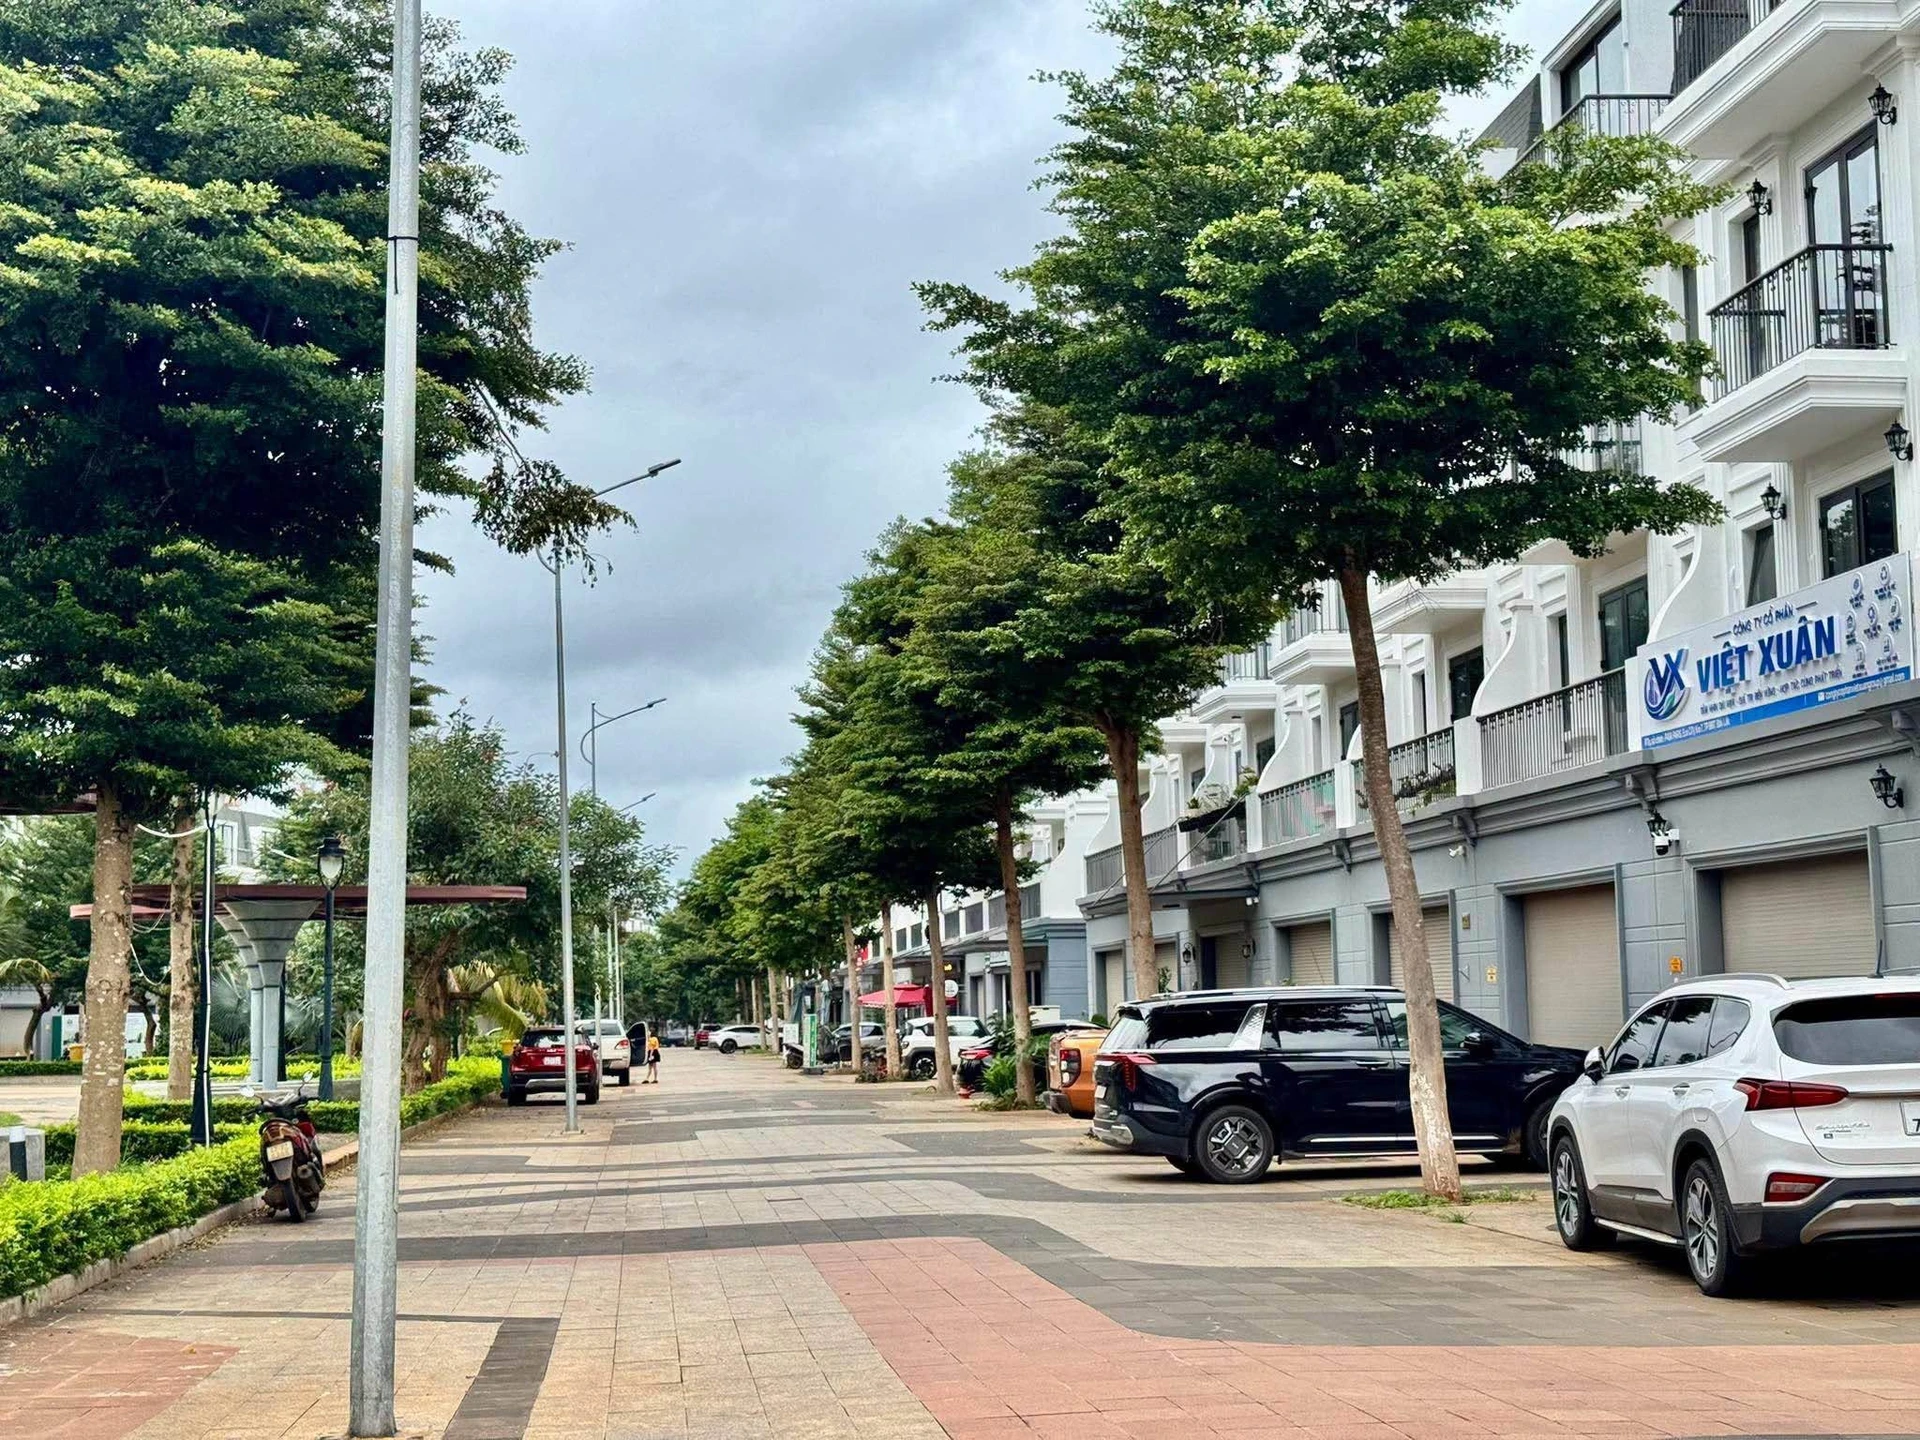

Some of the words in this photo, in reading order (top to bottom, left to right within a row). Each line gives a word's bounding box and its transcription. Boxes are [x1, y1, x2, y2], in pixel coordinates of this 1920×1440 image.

[1733, 619, 1752, 635] CÔNG
[1753, 616, 1762, 628] TY
[1697, 641, 1749, 694] VIỆT
[1758, 616, 1835, 676] XUÂN
